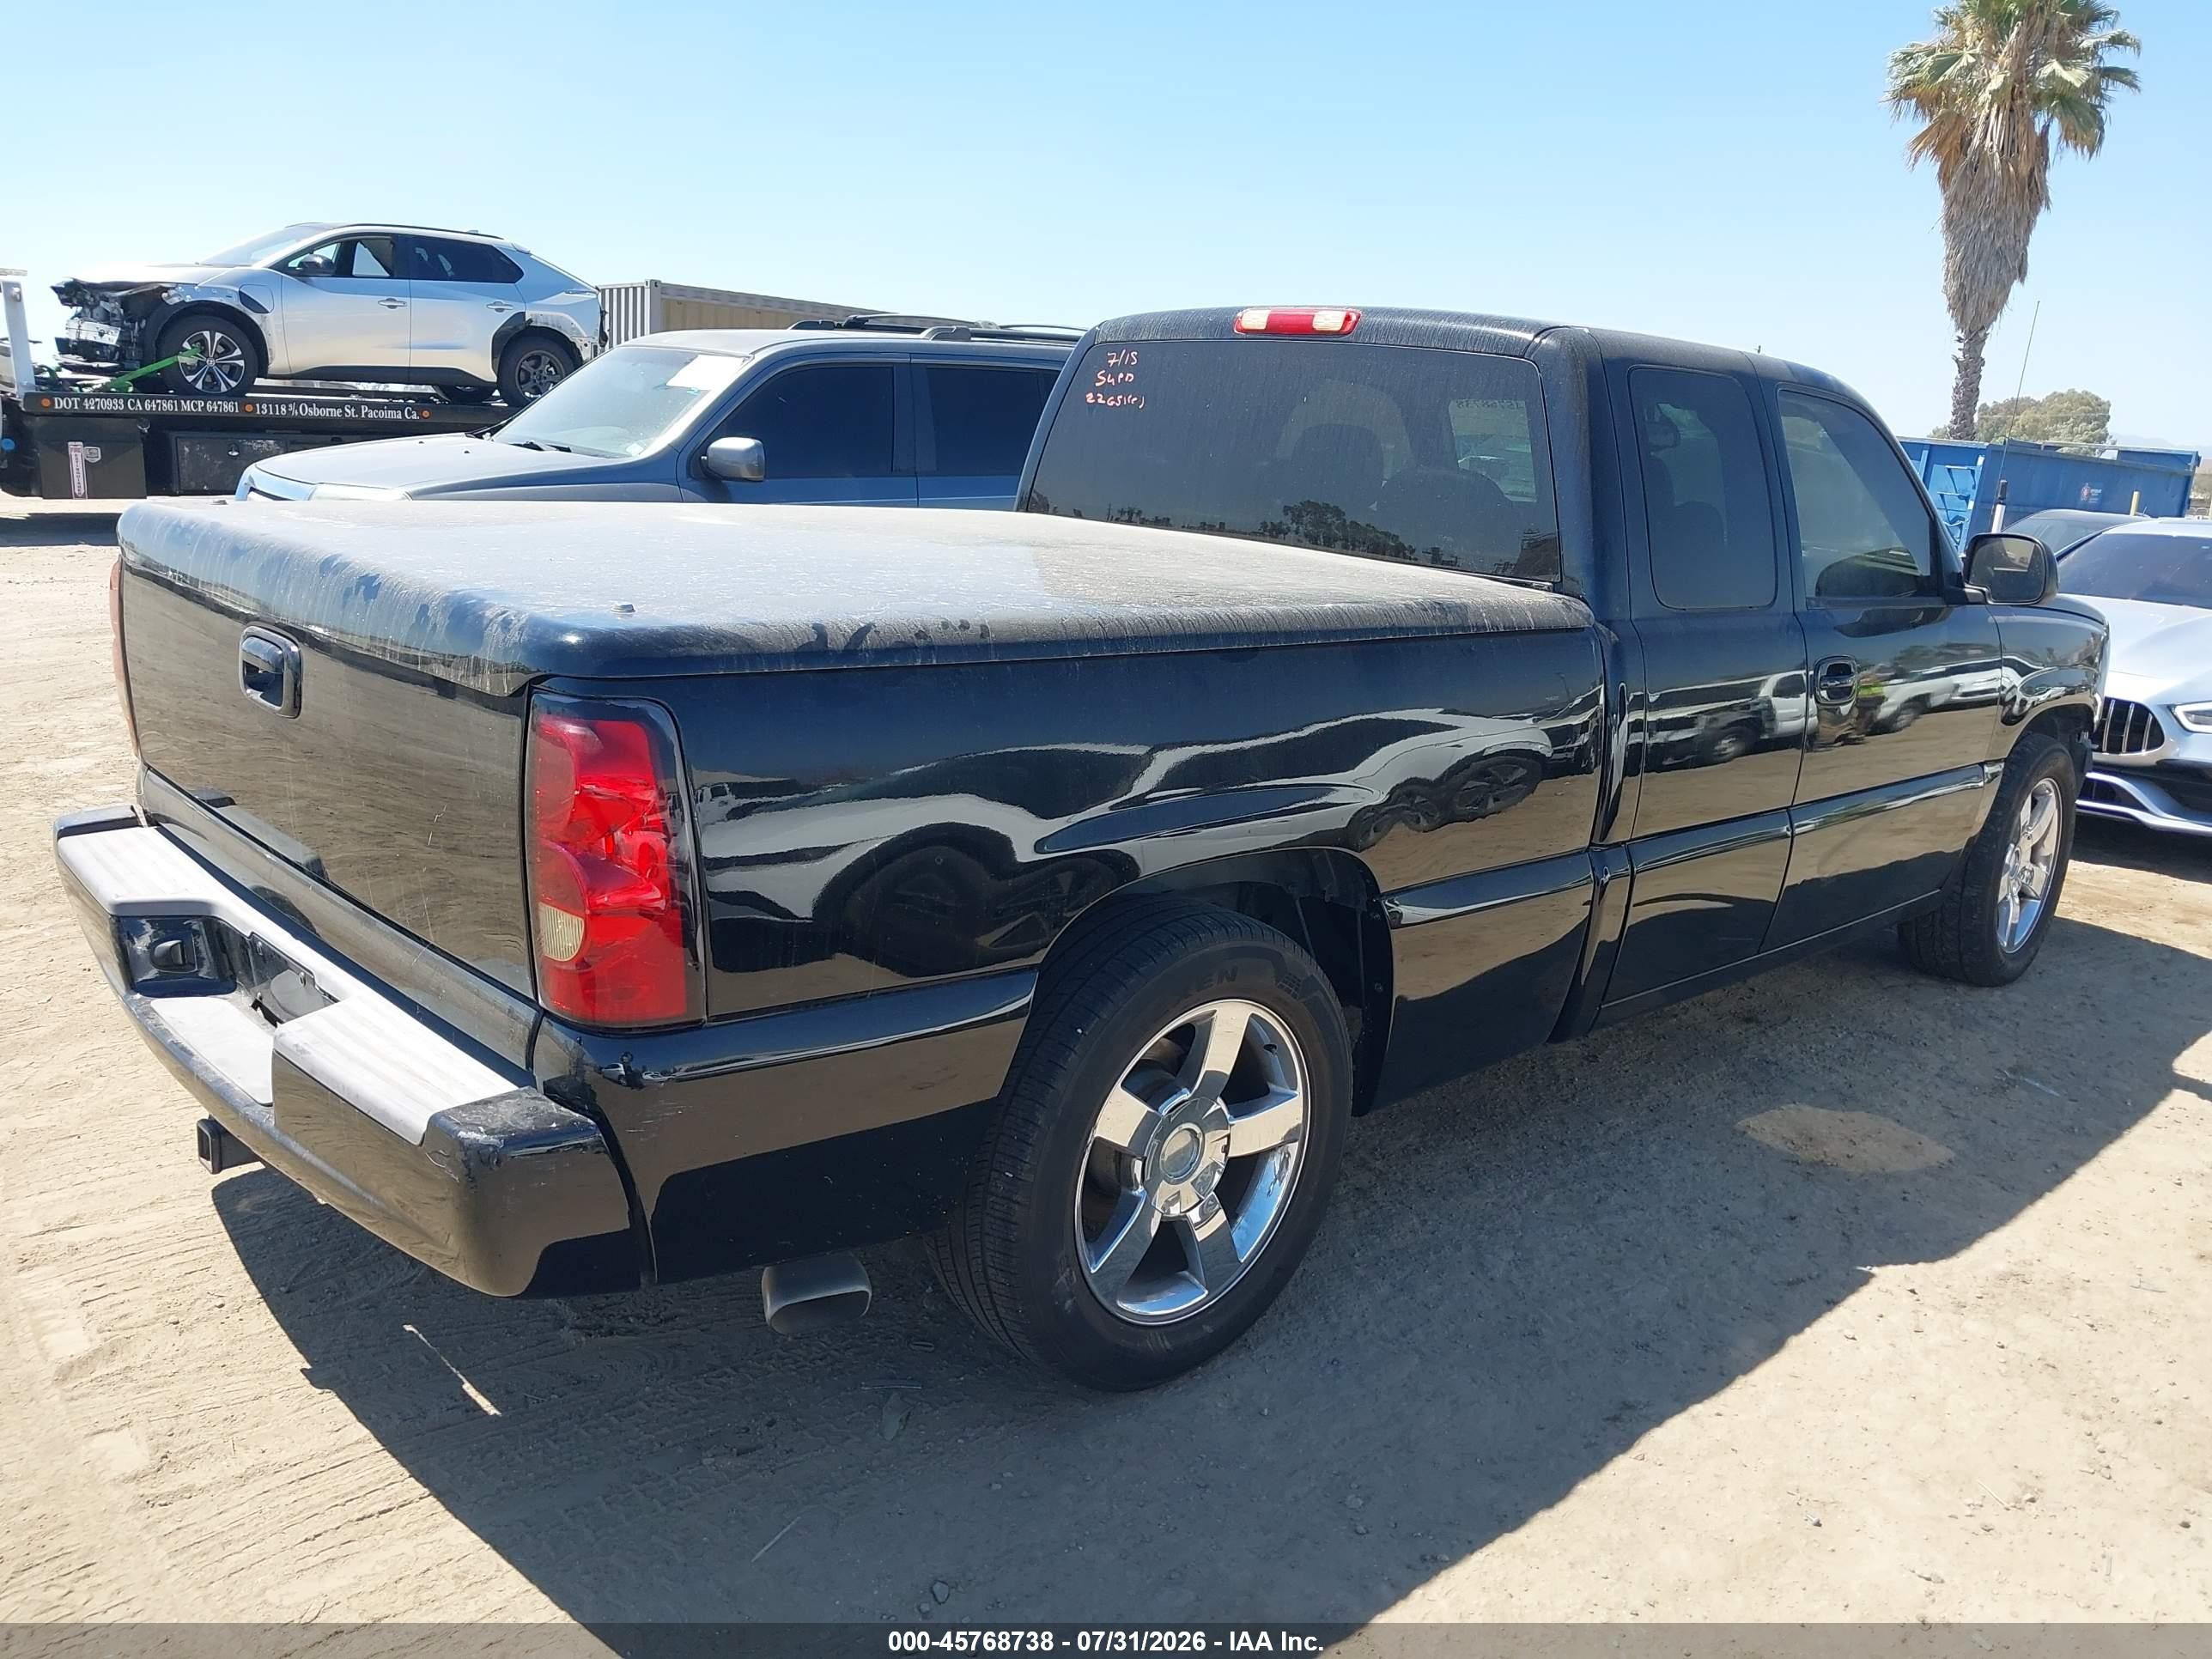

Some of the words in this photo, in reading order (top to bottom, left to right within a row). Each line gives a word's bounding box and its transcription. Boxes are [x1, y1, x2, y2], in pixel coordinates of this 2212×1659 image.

[54, 397, 81, 410] DOT
[82, 398, 125, 410] 4270933
[127, 398, 143, 411] CA
[144, 399, 179, 412] 647861
[180, 399, 204, 412] MCP
[206, 400, 240, 413] 647861
[255, 404, 287, 416] 13118
[299, 403, 343, 418] Osborne
[344, 404, 359, 418] St.
[361, 405, 402, 419] Pacoima
[404, 407, 420, 420] Ca.
